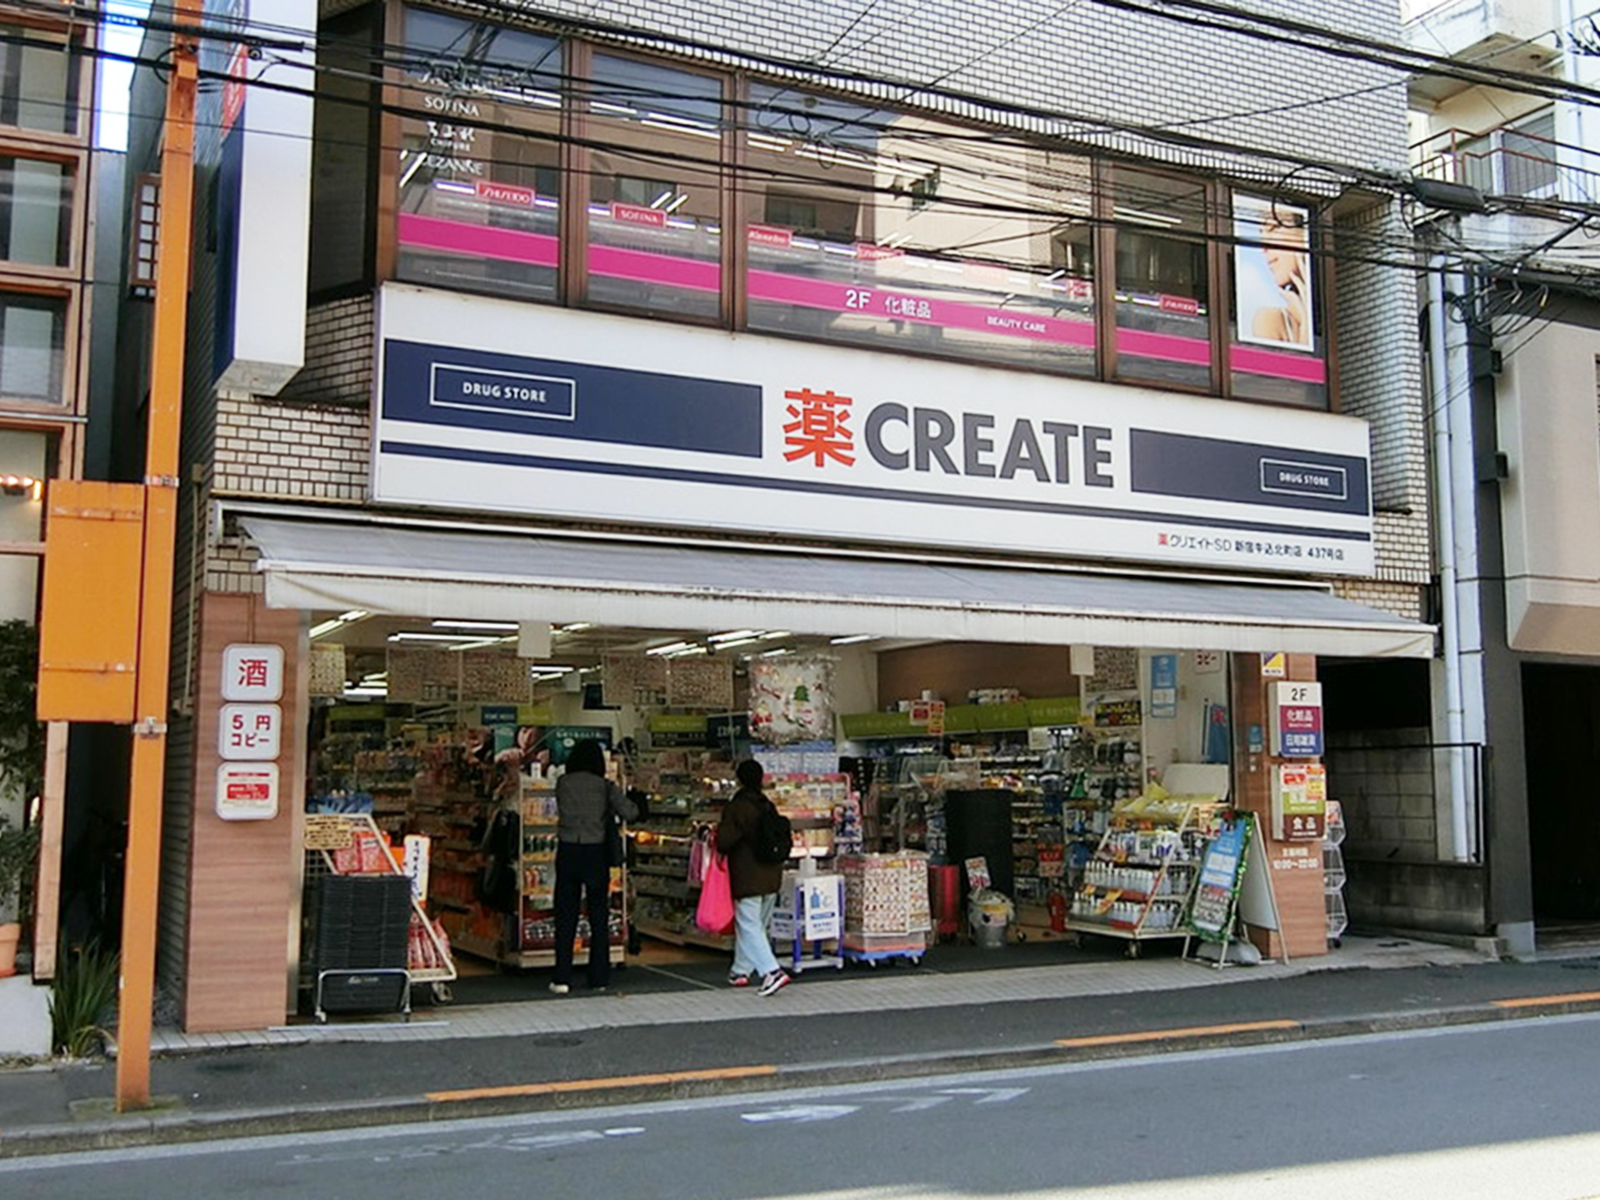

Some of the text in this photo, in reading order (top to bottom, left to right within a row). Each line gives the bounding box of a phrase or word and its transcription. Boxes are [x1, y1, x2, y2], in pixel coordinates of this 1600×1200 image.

[424, 95, 480, 117] SOFINA
[845, 288, 932, 319] 2F 化粧品
[986, 315, 1046, 334] BEAUTY CARE
[462, 381, 546, 403] DRUG STORE
[782, 388, 1115, 489] 薬 CREATE
[1279, 471, 1330, 487] DRUG STORE
[238, 658, 269, 688] 酒
[1290, 687, 1308, 702] 2F
[231, 732, 270, 749] コピー
